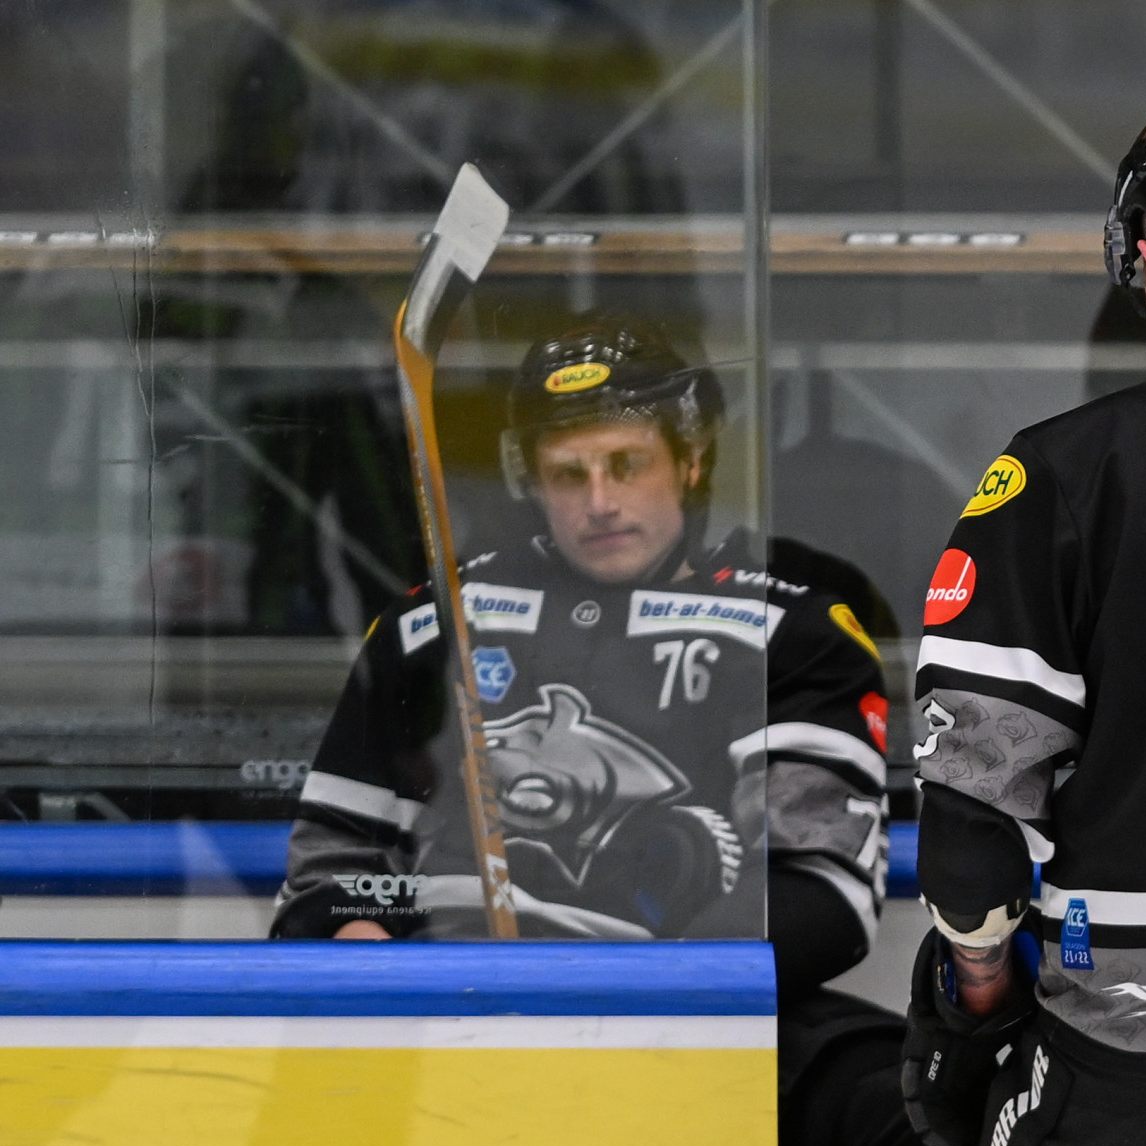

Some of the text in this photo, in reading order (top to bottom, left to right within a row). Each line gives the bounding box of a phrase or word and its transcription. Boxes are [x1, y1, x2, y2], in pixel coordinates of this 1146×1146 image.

[639, 599, 768, 628] bet-at-home
[654, 638, 720, 711] 76
[1067, 907, 1086, 928] ICE
